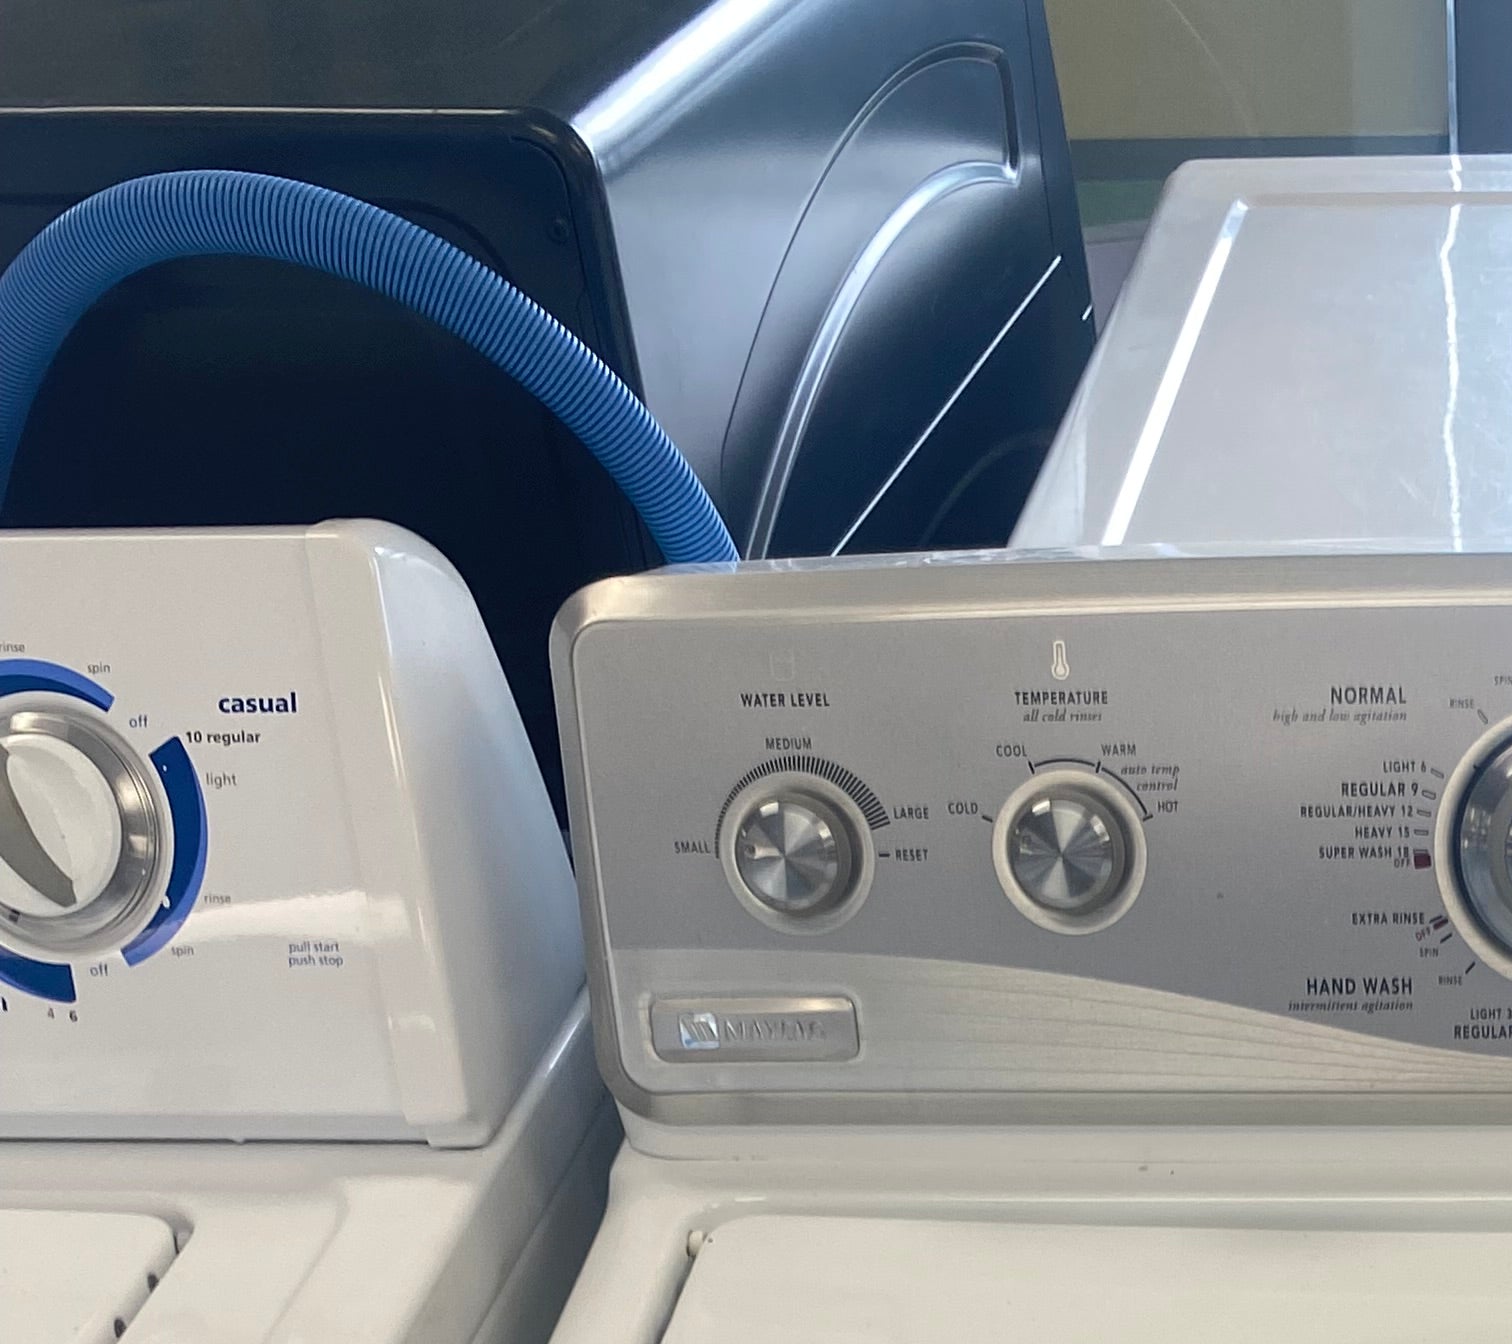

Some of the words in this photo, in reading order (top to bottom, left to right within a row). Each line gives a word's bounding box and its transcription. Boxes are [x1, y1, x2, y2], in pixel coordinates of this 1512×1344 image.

[87, 662, 111, 674] spin
[740, 693, 785, 707] WATER
[791, 693, 830, 707] LEVEL
[1015, 691, 1108, 705] TEMPERATURE
[1330, 686, 1407, 705] NORMAL
[218, 692, 298, 713] casual
[129, 716, 148, 728] off
[1024, 710, 1039, 722] all
[1042, 710, 1066, 722] cold
[1070, 711, 1102, 722] rinses
[1272, 709, 1298, 725] high
[1302, 709, 1326, 722] and
[1329, 709, 1349, 721] low
[1354, 710, 1407, 726] agitation
[186, 731, 202, 743] 10
[207, 732, 260, 746] regular
[765, 738, 812, 750] MEDIUM
[996, 745, 1027, 757] COOL
[1101, 744, 1136, 756] WARM
[1121, 766, 1147, 775] auto
[1151, 764, 1180, 777] temp
[1383, 761, 1416, 773] LIGHT
[1420, 761, 1427, 773] 6
[206, 772, 237, 790] light
[1136, 778, 1178, 791] control
[1341, 783, 1406, 797] REGULAR
[1411, 783, 1418, 796] 9
[948, 803, 978, 815] COLD
[1157, 801, 1178, 813] HOT
[1300, 805, 1395, 818] REGULAR/HEAVY
[1401, 806, 1413, 817] 12
[893, 808, 929, 820] LARGE
[1355, 827, 1392, 838] HEAVY
[1398, 827, 1410, 838] 15
[674, 842, 711, 854] SMALL
[1319, 847, 1354, 859] SUPER
[1359, 847, 1392, 858] WASH
[1397, 847, 1409, 858] 18
[895, 849, 928, 861] RESET
[1394, 859, 1410, 867] OFF
[204, 894, 231, 905] rinse
[1352, 913, 1387, 925] EXTRA
[1393, 913, 1425, 925] RINSE
[171, 945, 194, 959] spin
[289, 940, 310, 954] pull
[313, 941, 340, 953] start
[289, 954, 316, 968] push
[319, 955, 343, 968] stop
[90, 963, 108, 977] off
[1306, 978, 1356, 996] HAND
[1362, 977, 1412, 995] WASH
[1438, 976, 1463, 985] RINSE
[1288, 1001, 1357, 1012] intermittent
[1361, 1001, 1413, 1014] agitation
[1470, 1008, 1501, 1020] LIGHT
[1506, 1008, 1512, 1019] 3
